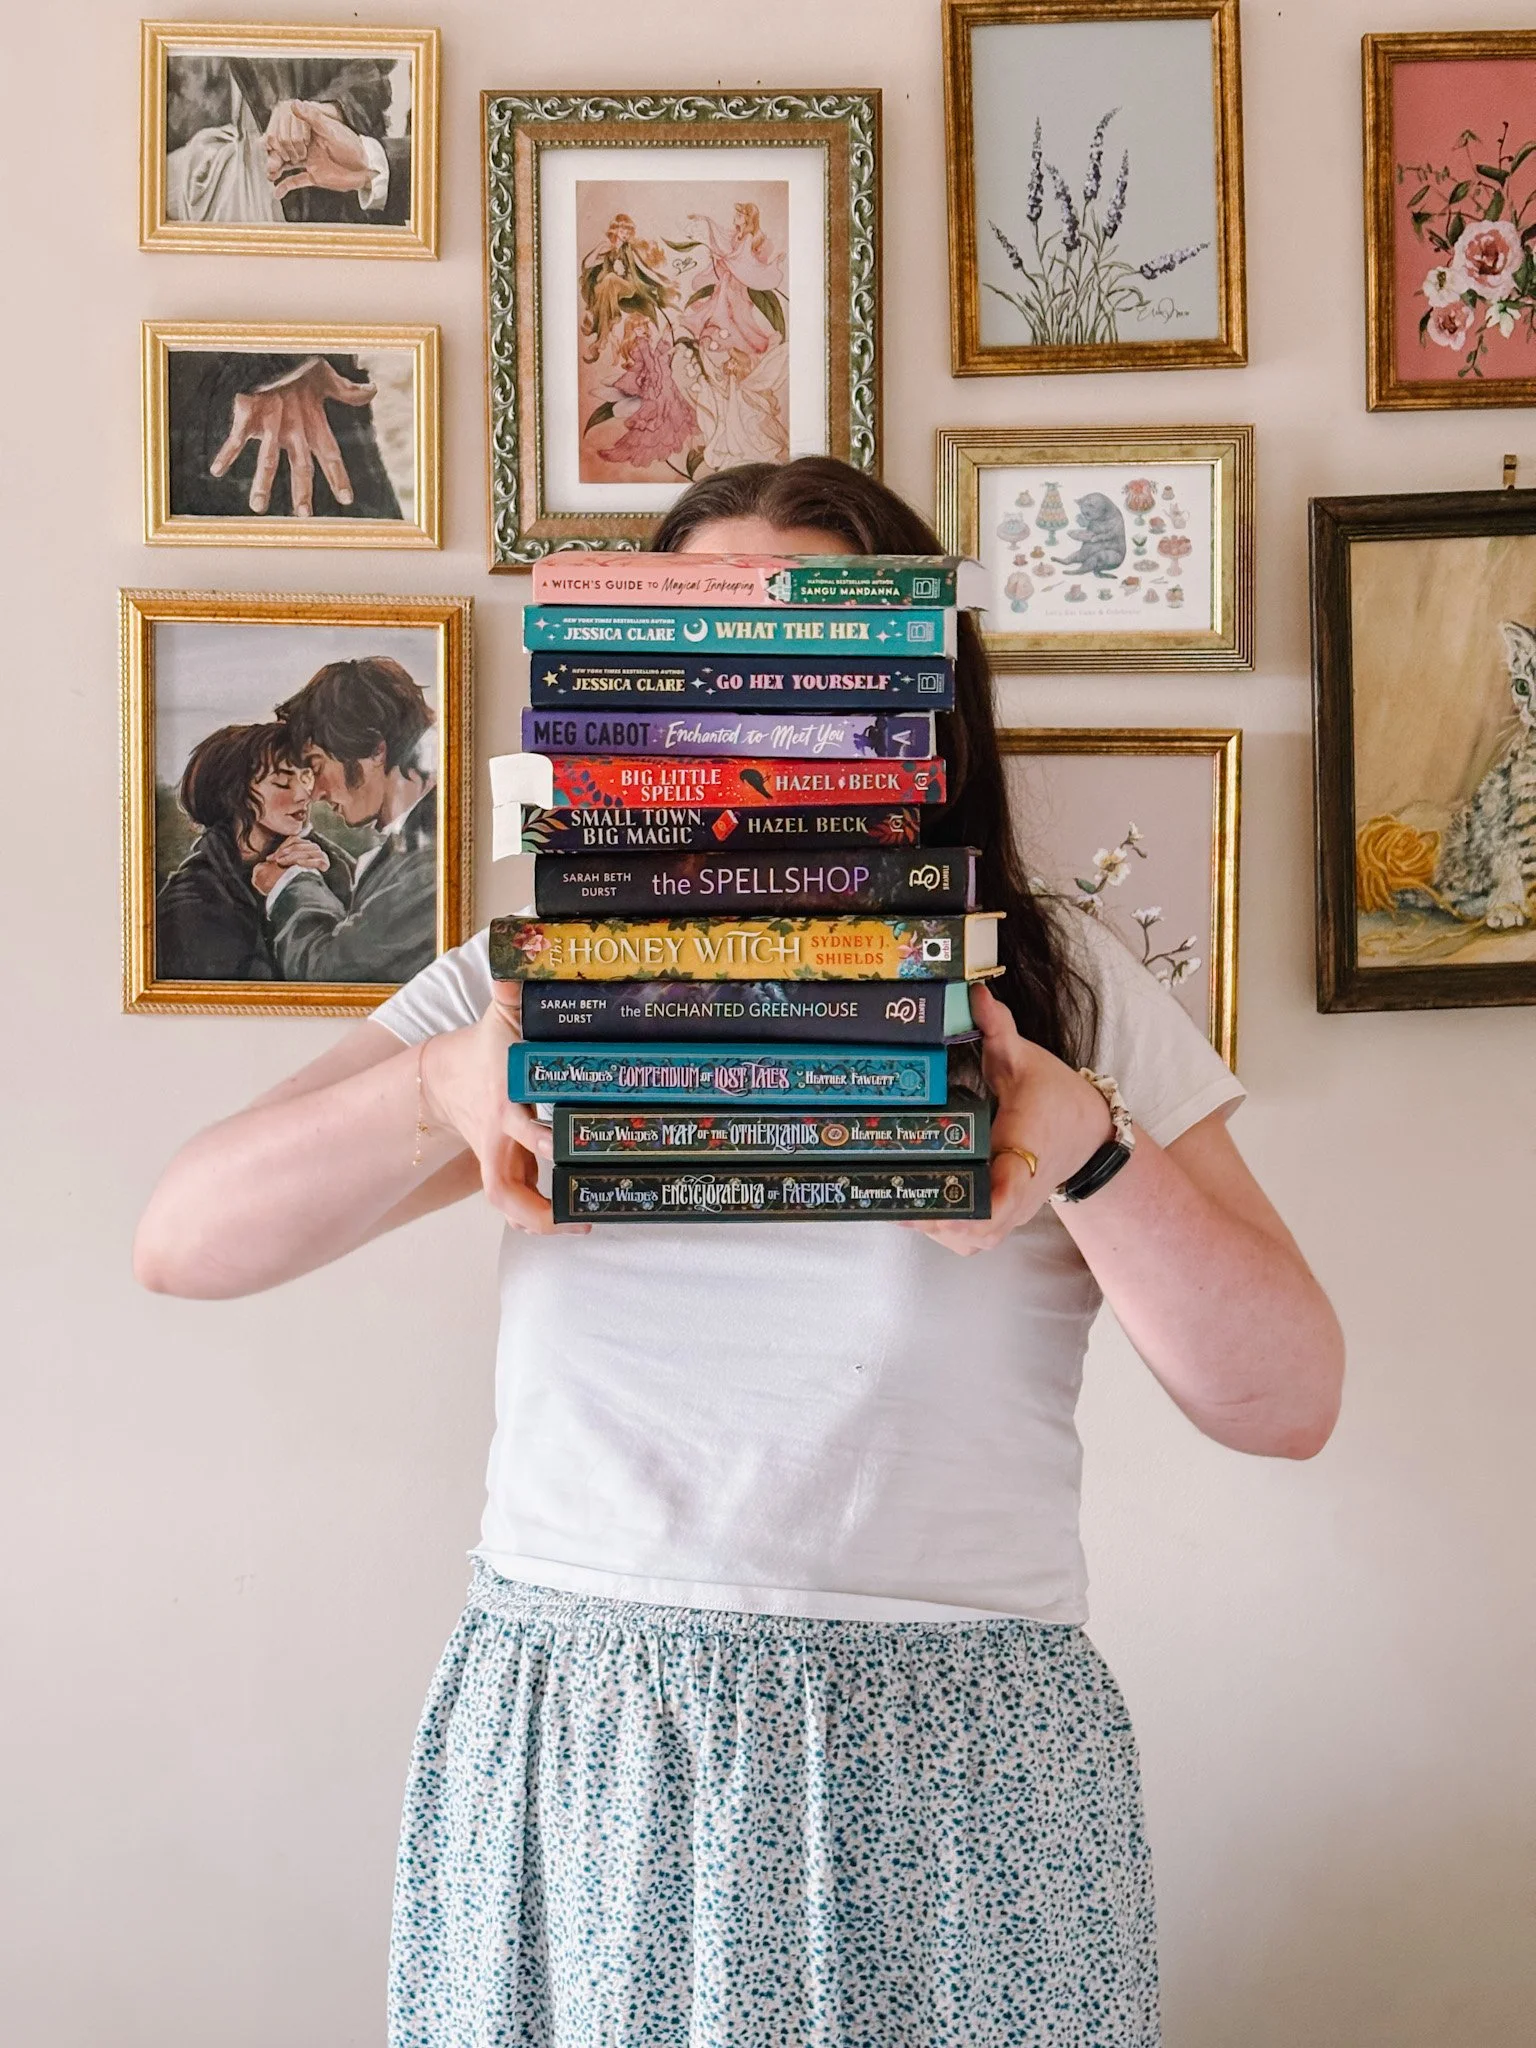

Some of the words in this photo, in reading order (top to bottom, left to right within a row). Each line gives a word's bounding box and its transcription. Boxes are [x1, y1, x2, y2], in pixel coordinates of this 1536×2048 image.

[542, 580, 548, 588] A
[552, 579, 601, 590] WITCH'S
[605, 580, 643, 590] GUIDE
[648, 581, 659, 589] TO
[662, 577, 700, 595] Magical
[703, 577, 755, 596] Innkeeping
[800, 587, 837, 596] SANGU
[840, 587, 900, 596] MANDANNA
[563, 627, 622, 641] JESSICA
[627, 627, 675, 641] CLARE
[715, 622, 777, 639] WHAT
[783, 622, 824, 639] THE
[830, 622, 870, 640] HEX
[572, 678, 632, 692] JESSICA
[636, 678, 686, 692] CLARE
[716, 674, 743, 689] GO
[750, 674, 784, 690] HEX
[792, 674, 891, 690] YOURSELF
[534, 721, 577, 746] MEG
[585, 722, 651, 746] CABOT
[665, 721, 742, 748] Enchanted
[741, 730, 769, 744] to
[771, 724, 818, 749] Meet
[815, 723, 845, 753] You
[621, 769, 653, 786] BIG
[662, 769, 722, 786] LITTLE
[775, 775, 835, 791] HAZEL
[850, 774, 901, 790] BECK
[641, 785, 705, 802] SPELLS
[571, 809, 637, 827] SMALL
[748, 817, 808, 833] HAZEL
[816, 816, 869, 833] BECK
[583, 828, 619, 845] BIG
[626, 827, 693, 845] MAGIC
[562, 873, 600, 883] SARAH
[604, 873, 632, 883] BETH
[652, 872, 691, 895] the
[699, 866, 869, 894] SPELLSHOP
[581, 887, 617, 897] DURST
[551, 937, 564, 966] The
[568, 937, 685, 964] HONEY
[693, 931, 800, 965] WITCH
[811, 936, 874, 948] SYDNEY
[816, 953, 884, 965] SHIELDS
[541, 1000, 576, 1009] SARAH
[580, 1000, 607, 1009] BETH
[621, 1004, 641, 1017] the
[644, 1003, 744, 1018] ENCHANTED
[749, 1002, 858, 1017] GREENHOUSE
[558, 1014, 593, 1024] DURST
[619, 1066, 700, 1088] COMPENDIUM
[713, 1067, 750, 1095] LOST
[743, 1062, 790, 1089] TALES
[662, 1124, 697, 1145] MAP
[697, 1129, 710, 1139] OF
[730, 1123, 820, 1153] OTHERLANDS
[662, 1175, 765, 1212] ENCYCLOPAEDIA
[782, 1182, 846, 1205] FAERIES
